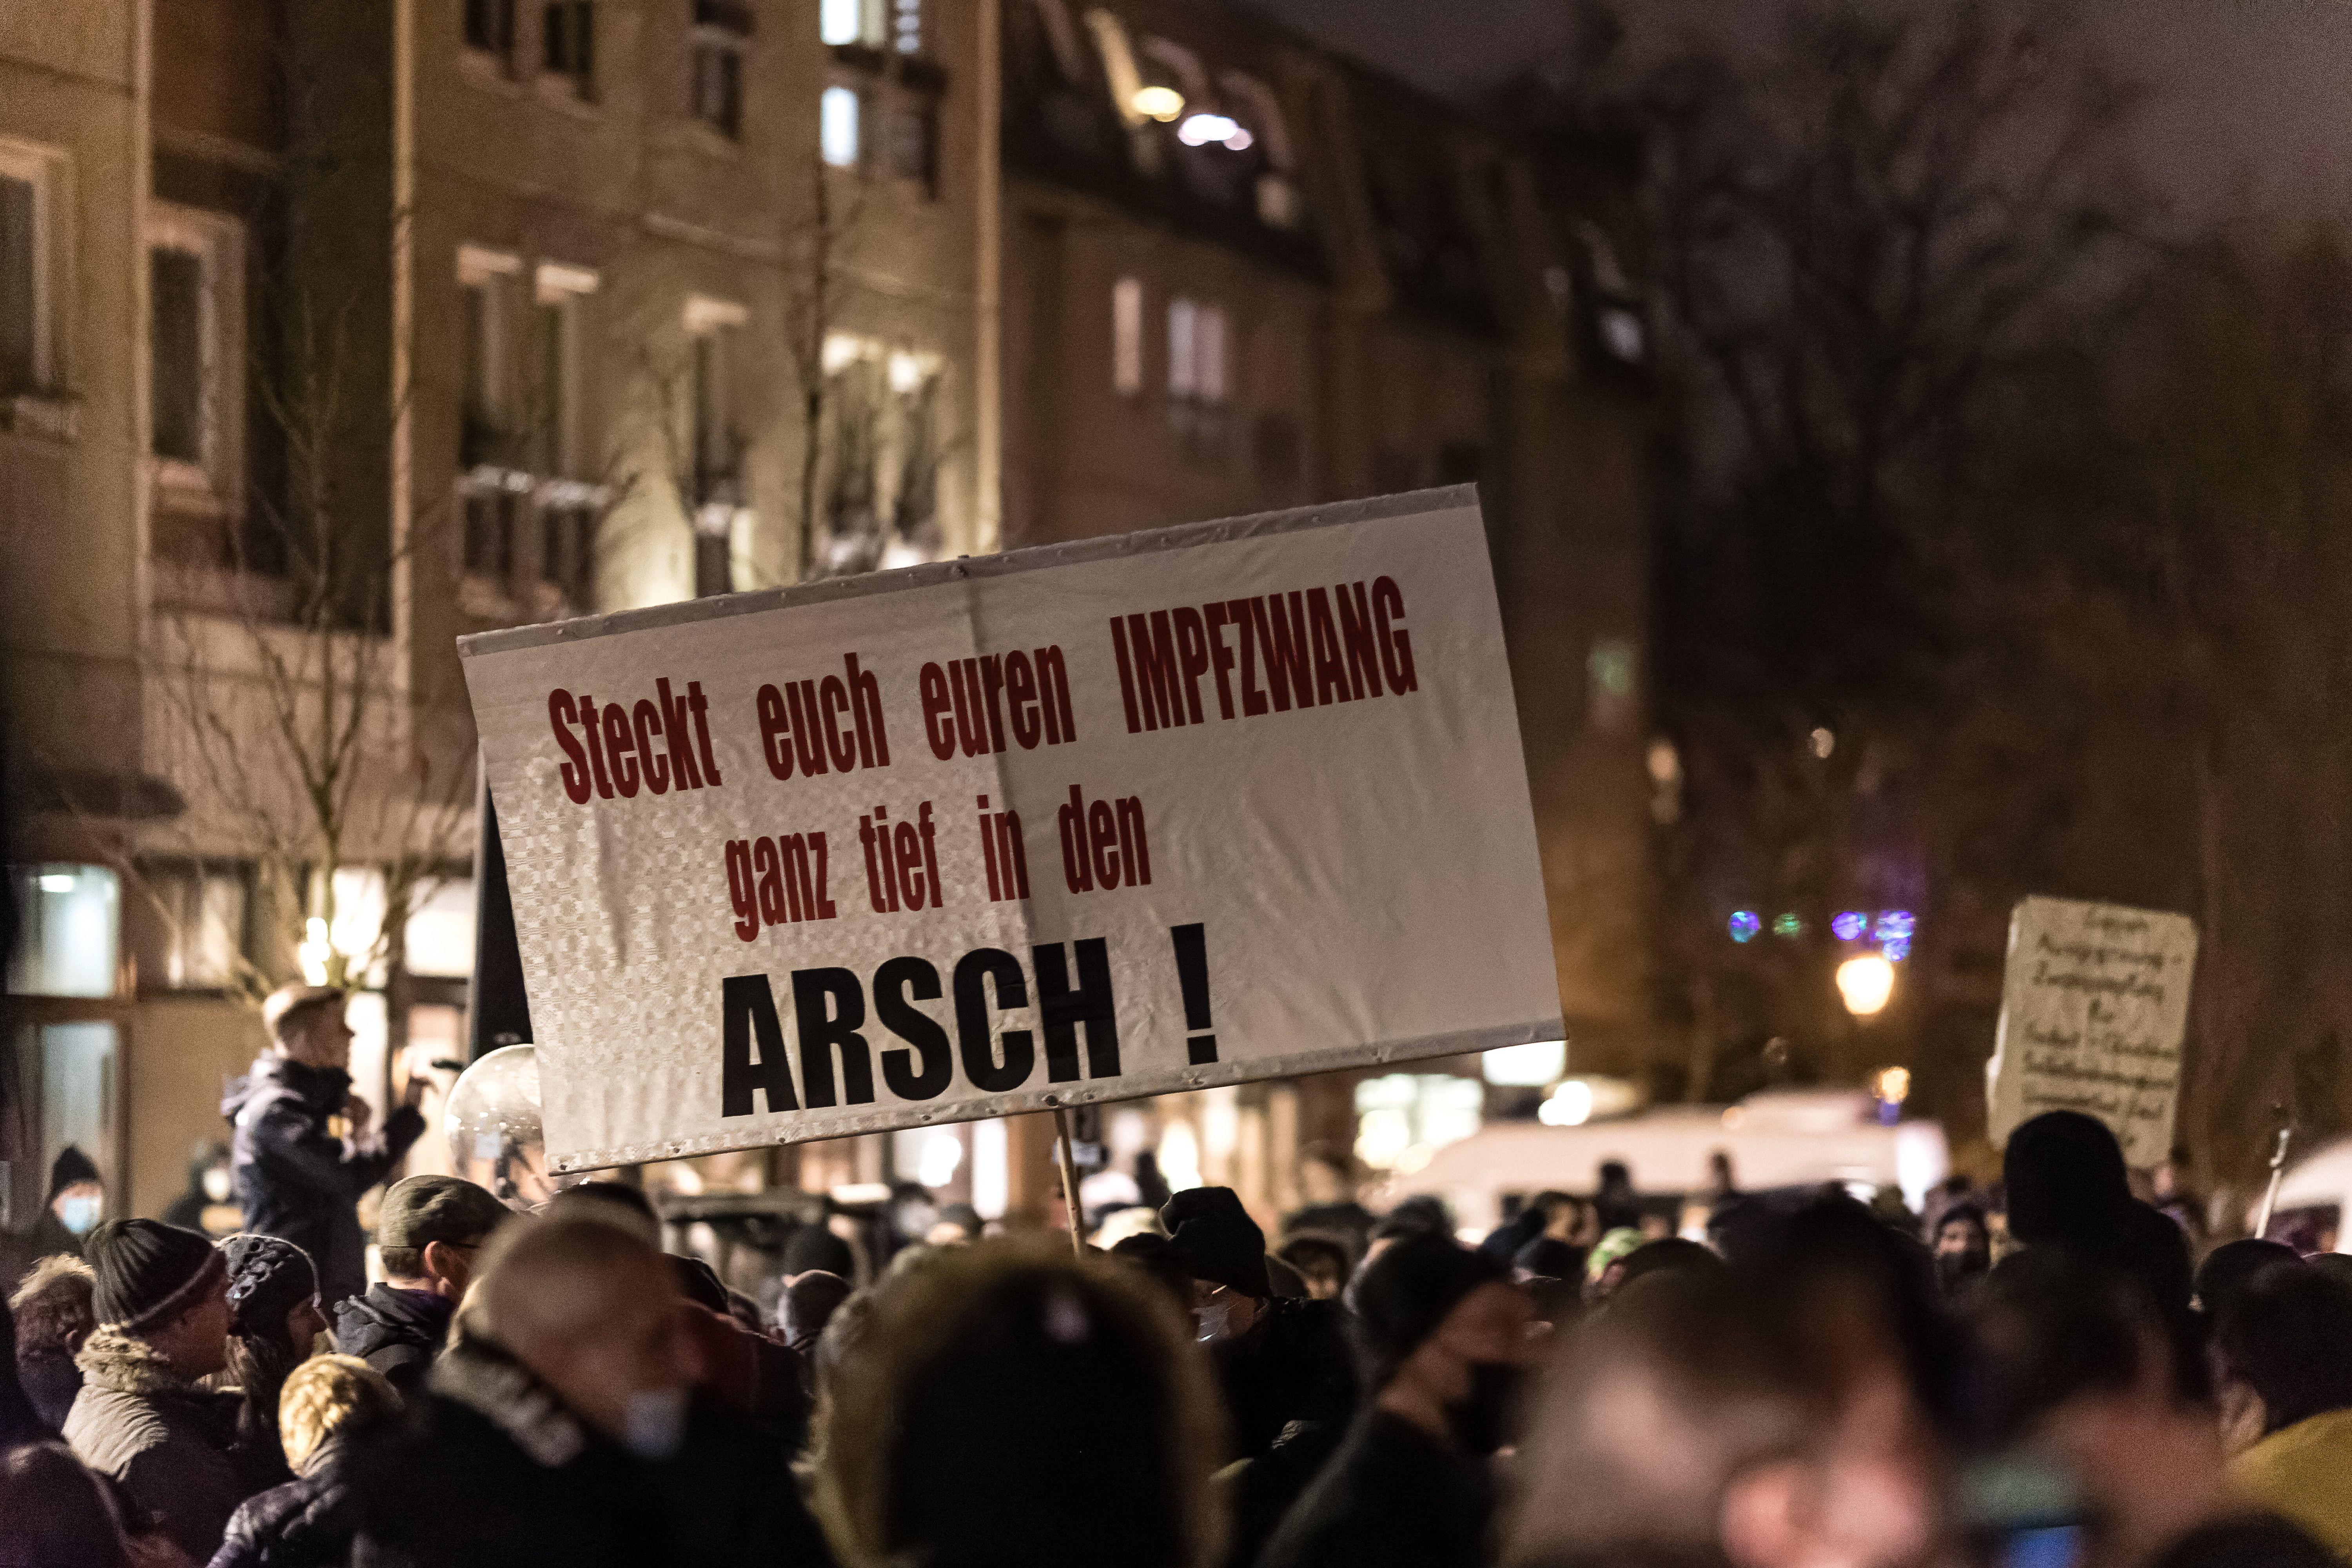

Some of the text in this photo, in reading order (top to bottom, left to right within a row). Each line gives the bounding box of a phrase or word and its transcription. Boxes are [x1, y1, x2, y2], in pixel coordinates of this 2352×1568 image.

[549, 576, 1417, 804] Steckt euch euren IMPFZWANG
[726, 785, 1151, 942] ganz tief in den
[722, 923, 1218, 1117] ARSCH !
